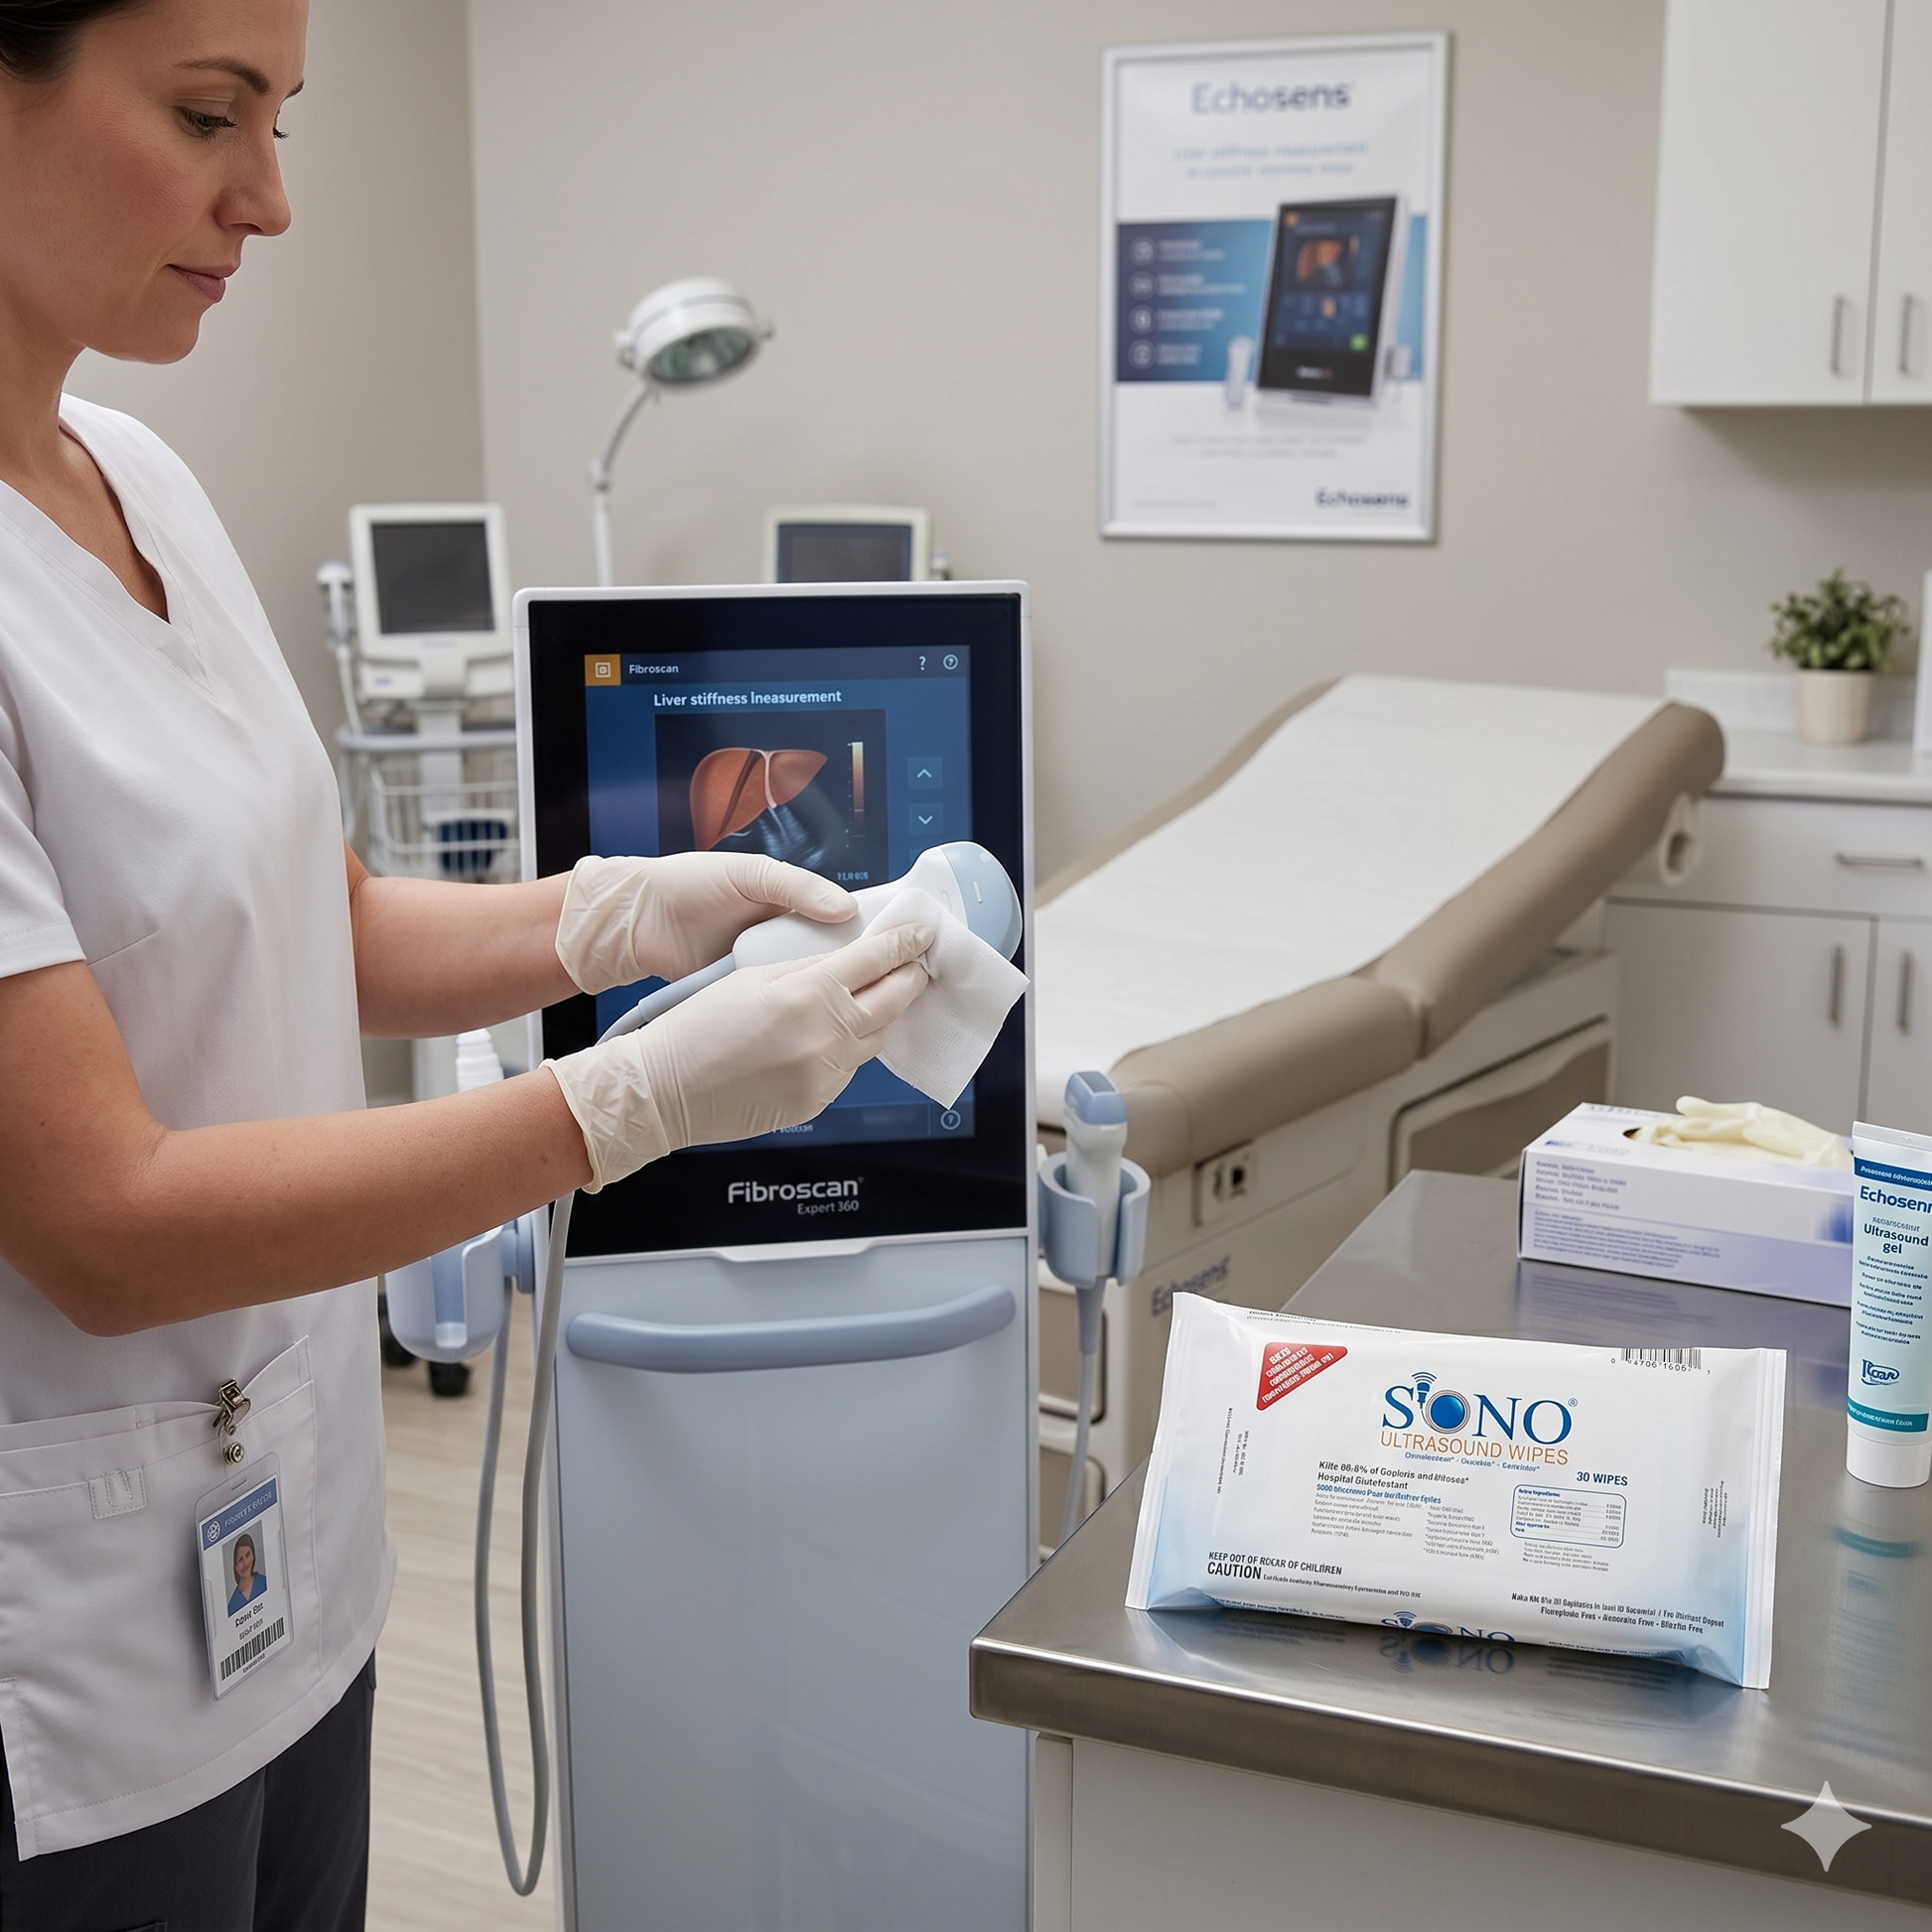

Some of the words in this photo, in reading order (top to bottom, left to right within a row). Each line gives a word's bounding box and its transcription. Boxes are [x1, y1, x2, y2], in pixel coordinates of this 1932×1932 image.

[628, 663, 679, 675] Fibroscan
[653, 694, 687, 706] Liver
[690, 692, 748, 706] stiffness
[728, 1178, 859, 1203] Fibroscan
[797, 1201, 836, 1216] Expert
[838, 1199, 860, 1212] 360
[1863, 1223, 1929, 1246] Ultrasound
[1882, 1242, 1902, 1254] gel
[1381, 1385, 1573, 1446] SONO
[1380, 1431, 1502, 1459] ULTRASOUND
[1508, 1444, 1569, 1465] WIPES
[1317, 1471, 1353, 1484] Hospital
[1576, 1471, 1589, 1482] 30
[1592, 1472, 1628, 1486] WIPES
[1208, 1551, 1228, 1562] KEEP
[1247, 1555, 1259, 1565] OF
[1288, 1560, 1299, 1570] OF
[1207, 1562, 1262, 1581] CAUTION
[1688, 1624, 1704, 1633] Free
